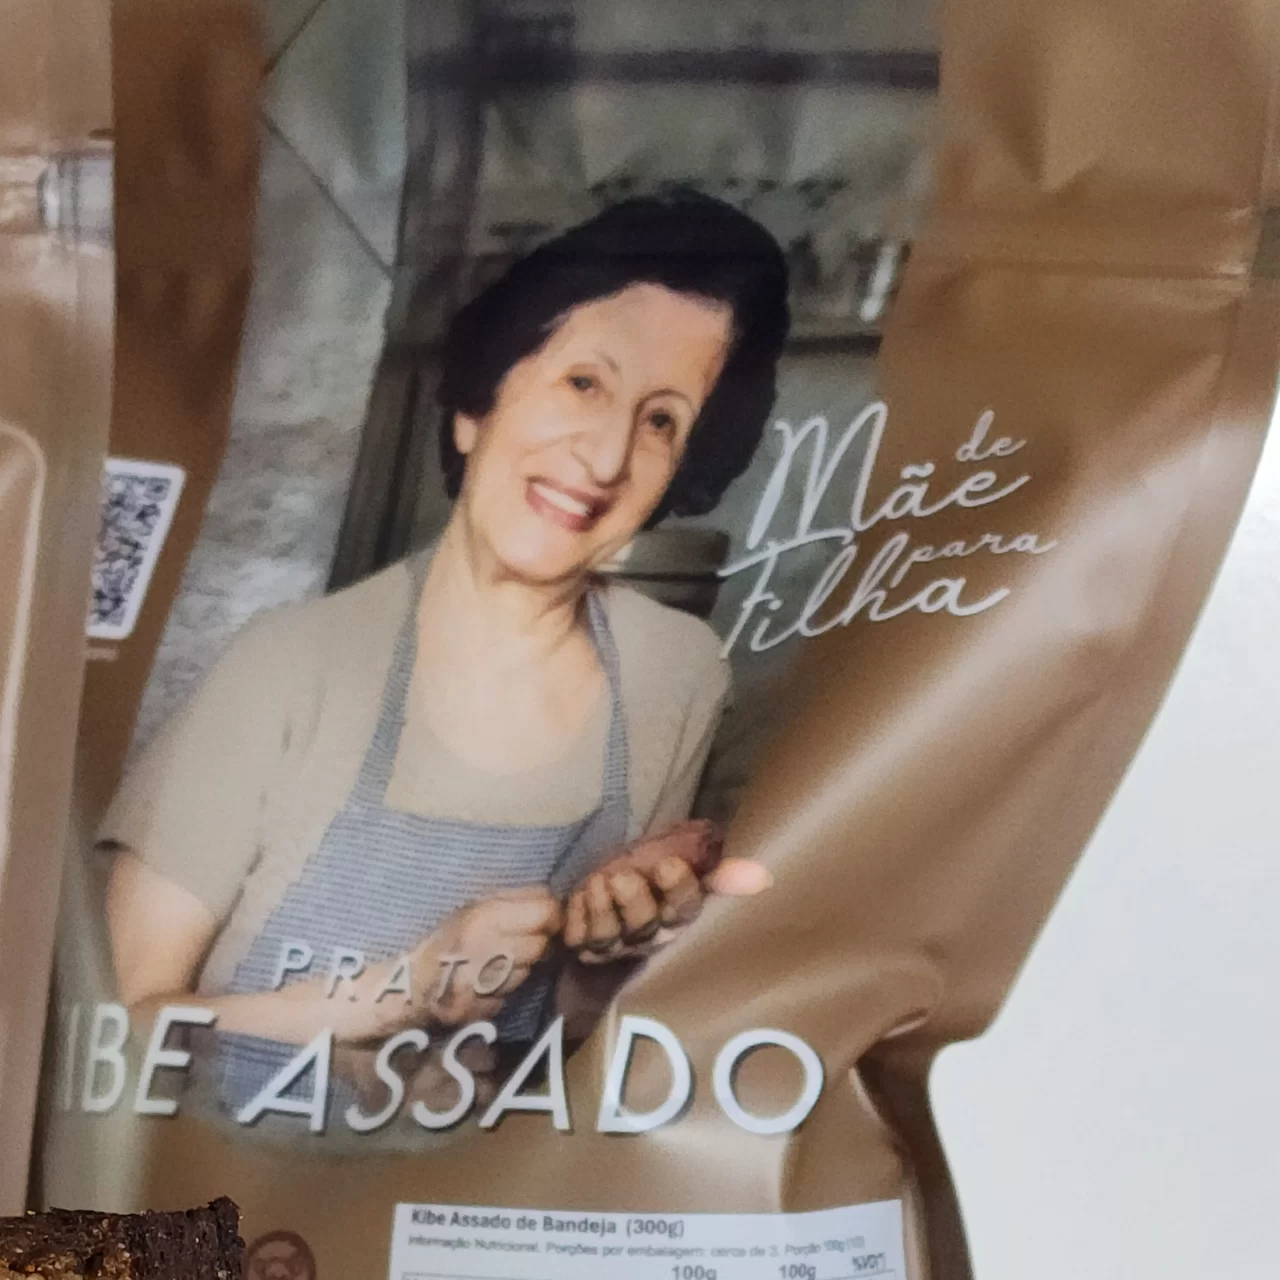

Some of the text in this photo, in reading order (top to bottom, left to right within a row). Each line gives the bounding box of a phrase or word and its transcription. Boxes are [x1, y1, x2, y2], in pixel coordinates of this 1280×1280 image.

[746, 401, 1031, 550] de Mãe
[716, 527, 1059, 659] para Filha
[272, 938, 516, 1006] PRATO
[63, 1002, 825, 1136] IBE ASSADO
[412, 1208, 685, 1240] Kibe Assado de Bandeja (300g)
